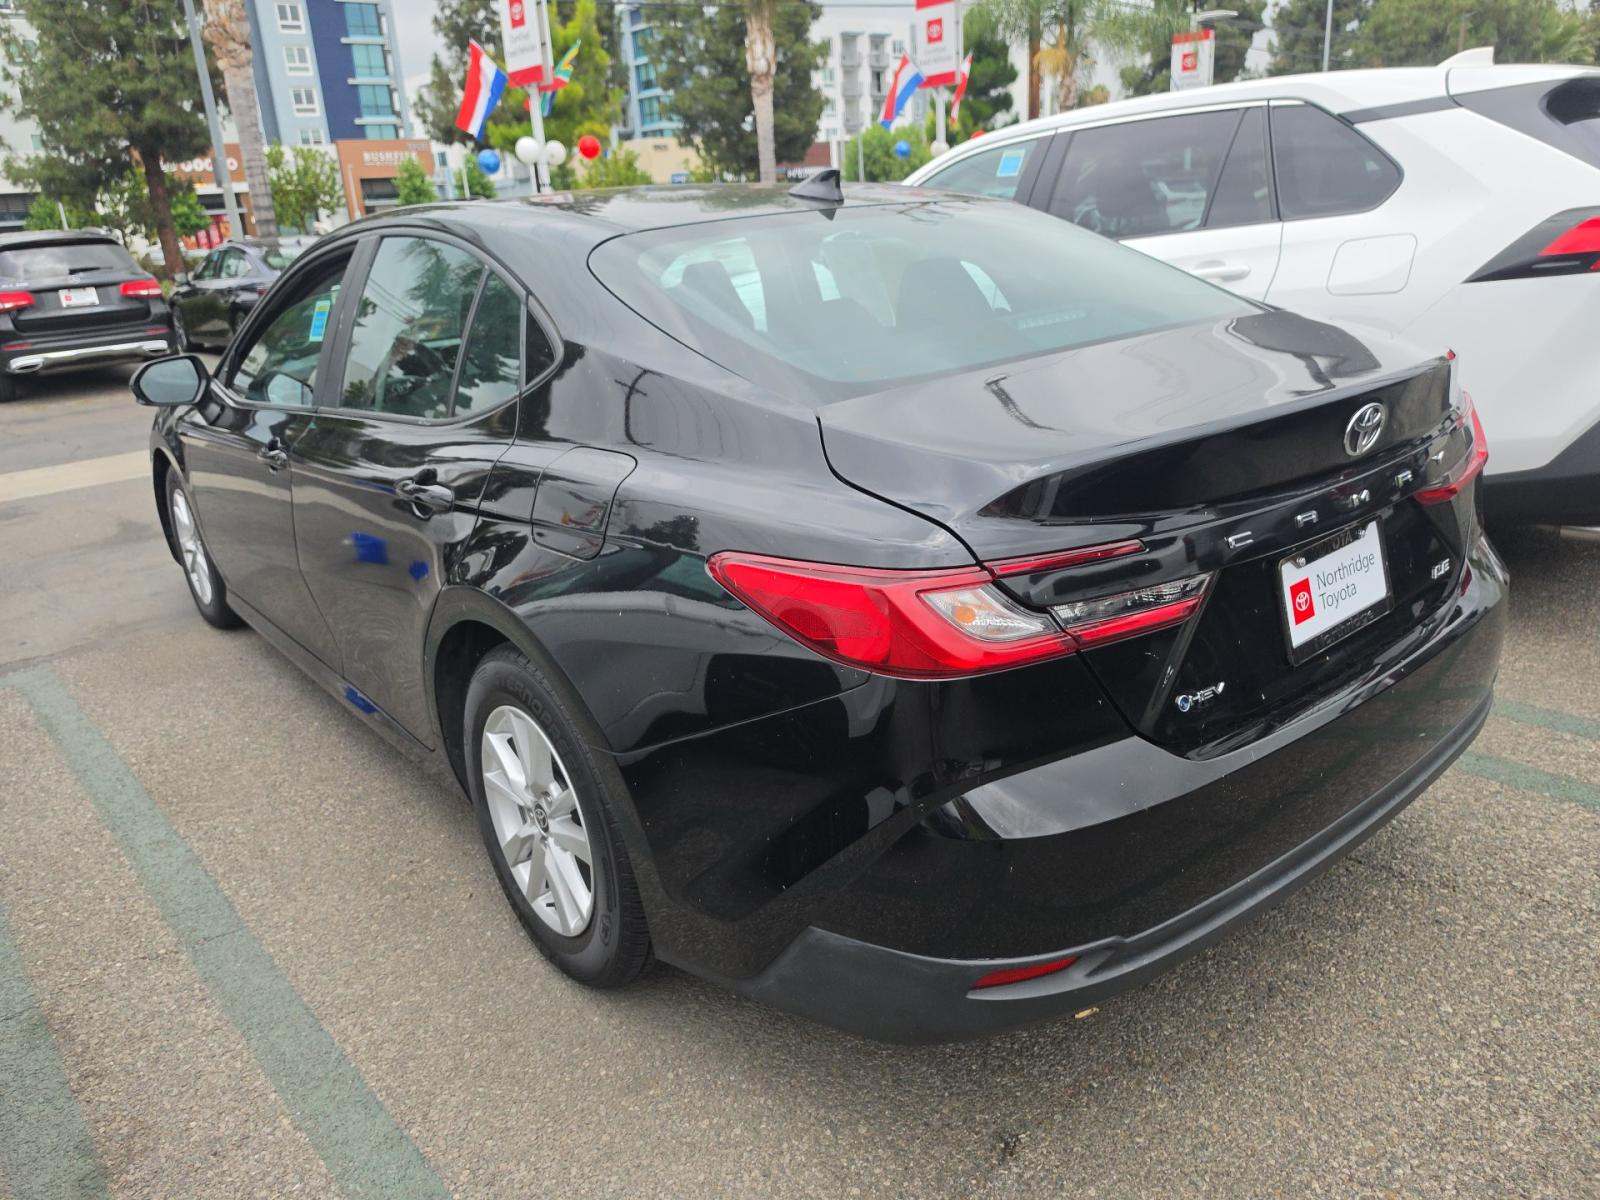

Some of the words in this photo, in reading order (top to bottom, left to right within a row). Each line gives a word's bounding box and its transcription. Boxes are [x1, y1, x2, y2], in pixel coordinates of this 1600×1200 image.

[1225, 451, 1445, 549] CAMRY
[1316, 552, 1376, 591] Northridge
[1319, 582, 1358, 609] Toyota
